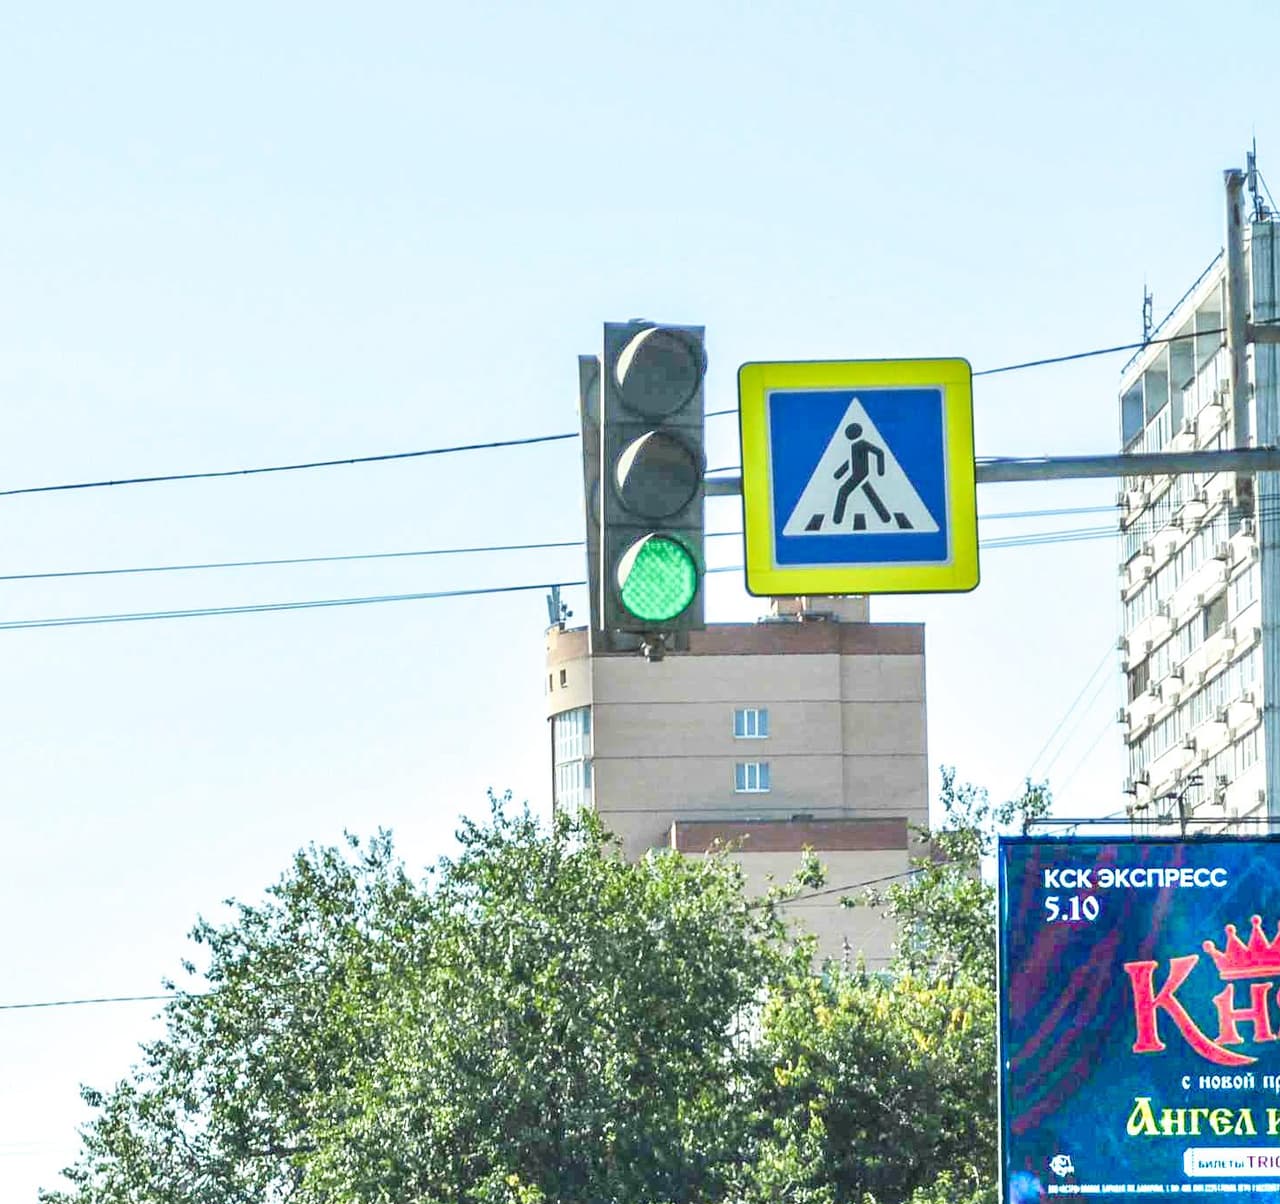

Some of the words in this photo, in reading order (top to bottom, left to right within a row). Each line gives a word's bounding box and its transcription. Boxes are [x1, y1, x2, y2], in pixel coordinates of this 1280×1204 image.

[1044, 868, 1092, 888] КСК
[1097, 868, 1227, 888] ЭКСПРЕСС
[1044, 896, 1100, 922] 5.10
[1181, 1075, 1191, 1090] с
[1199, 1071, 1255, 1090] новой
